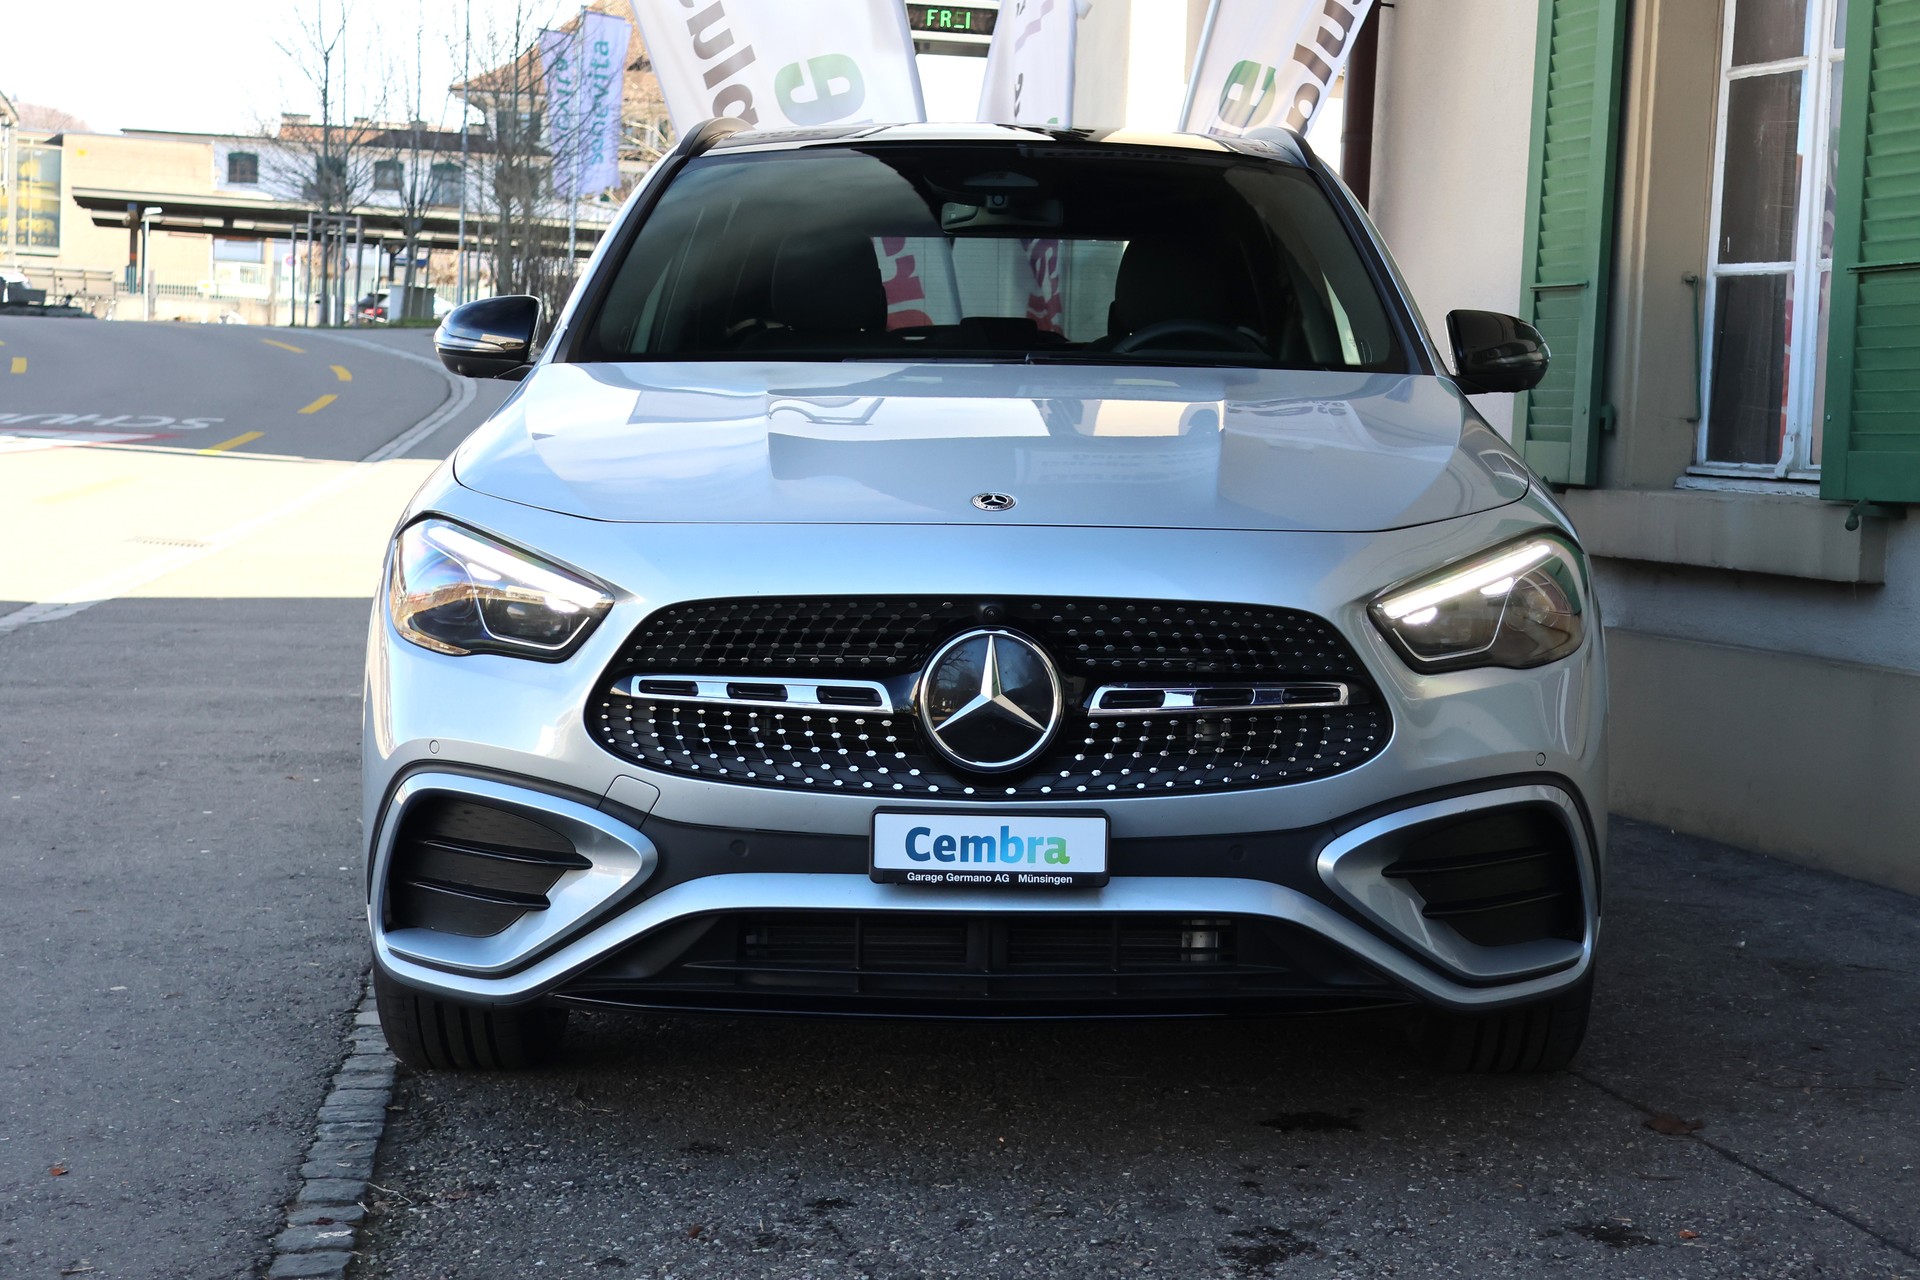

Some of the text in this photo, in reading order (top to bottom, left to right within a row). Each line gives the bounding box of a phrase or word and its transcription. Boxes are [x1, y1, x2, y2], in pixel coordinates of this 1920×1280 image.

[1286, 0, 1361, 134] plu
[905, 825, 1070, 865] Cembra
[907, 872, 1073, 885] Garage Germano AG Münsingen
